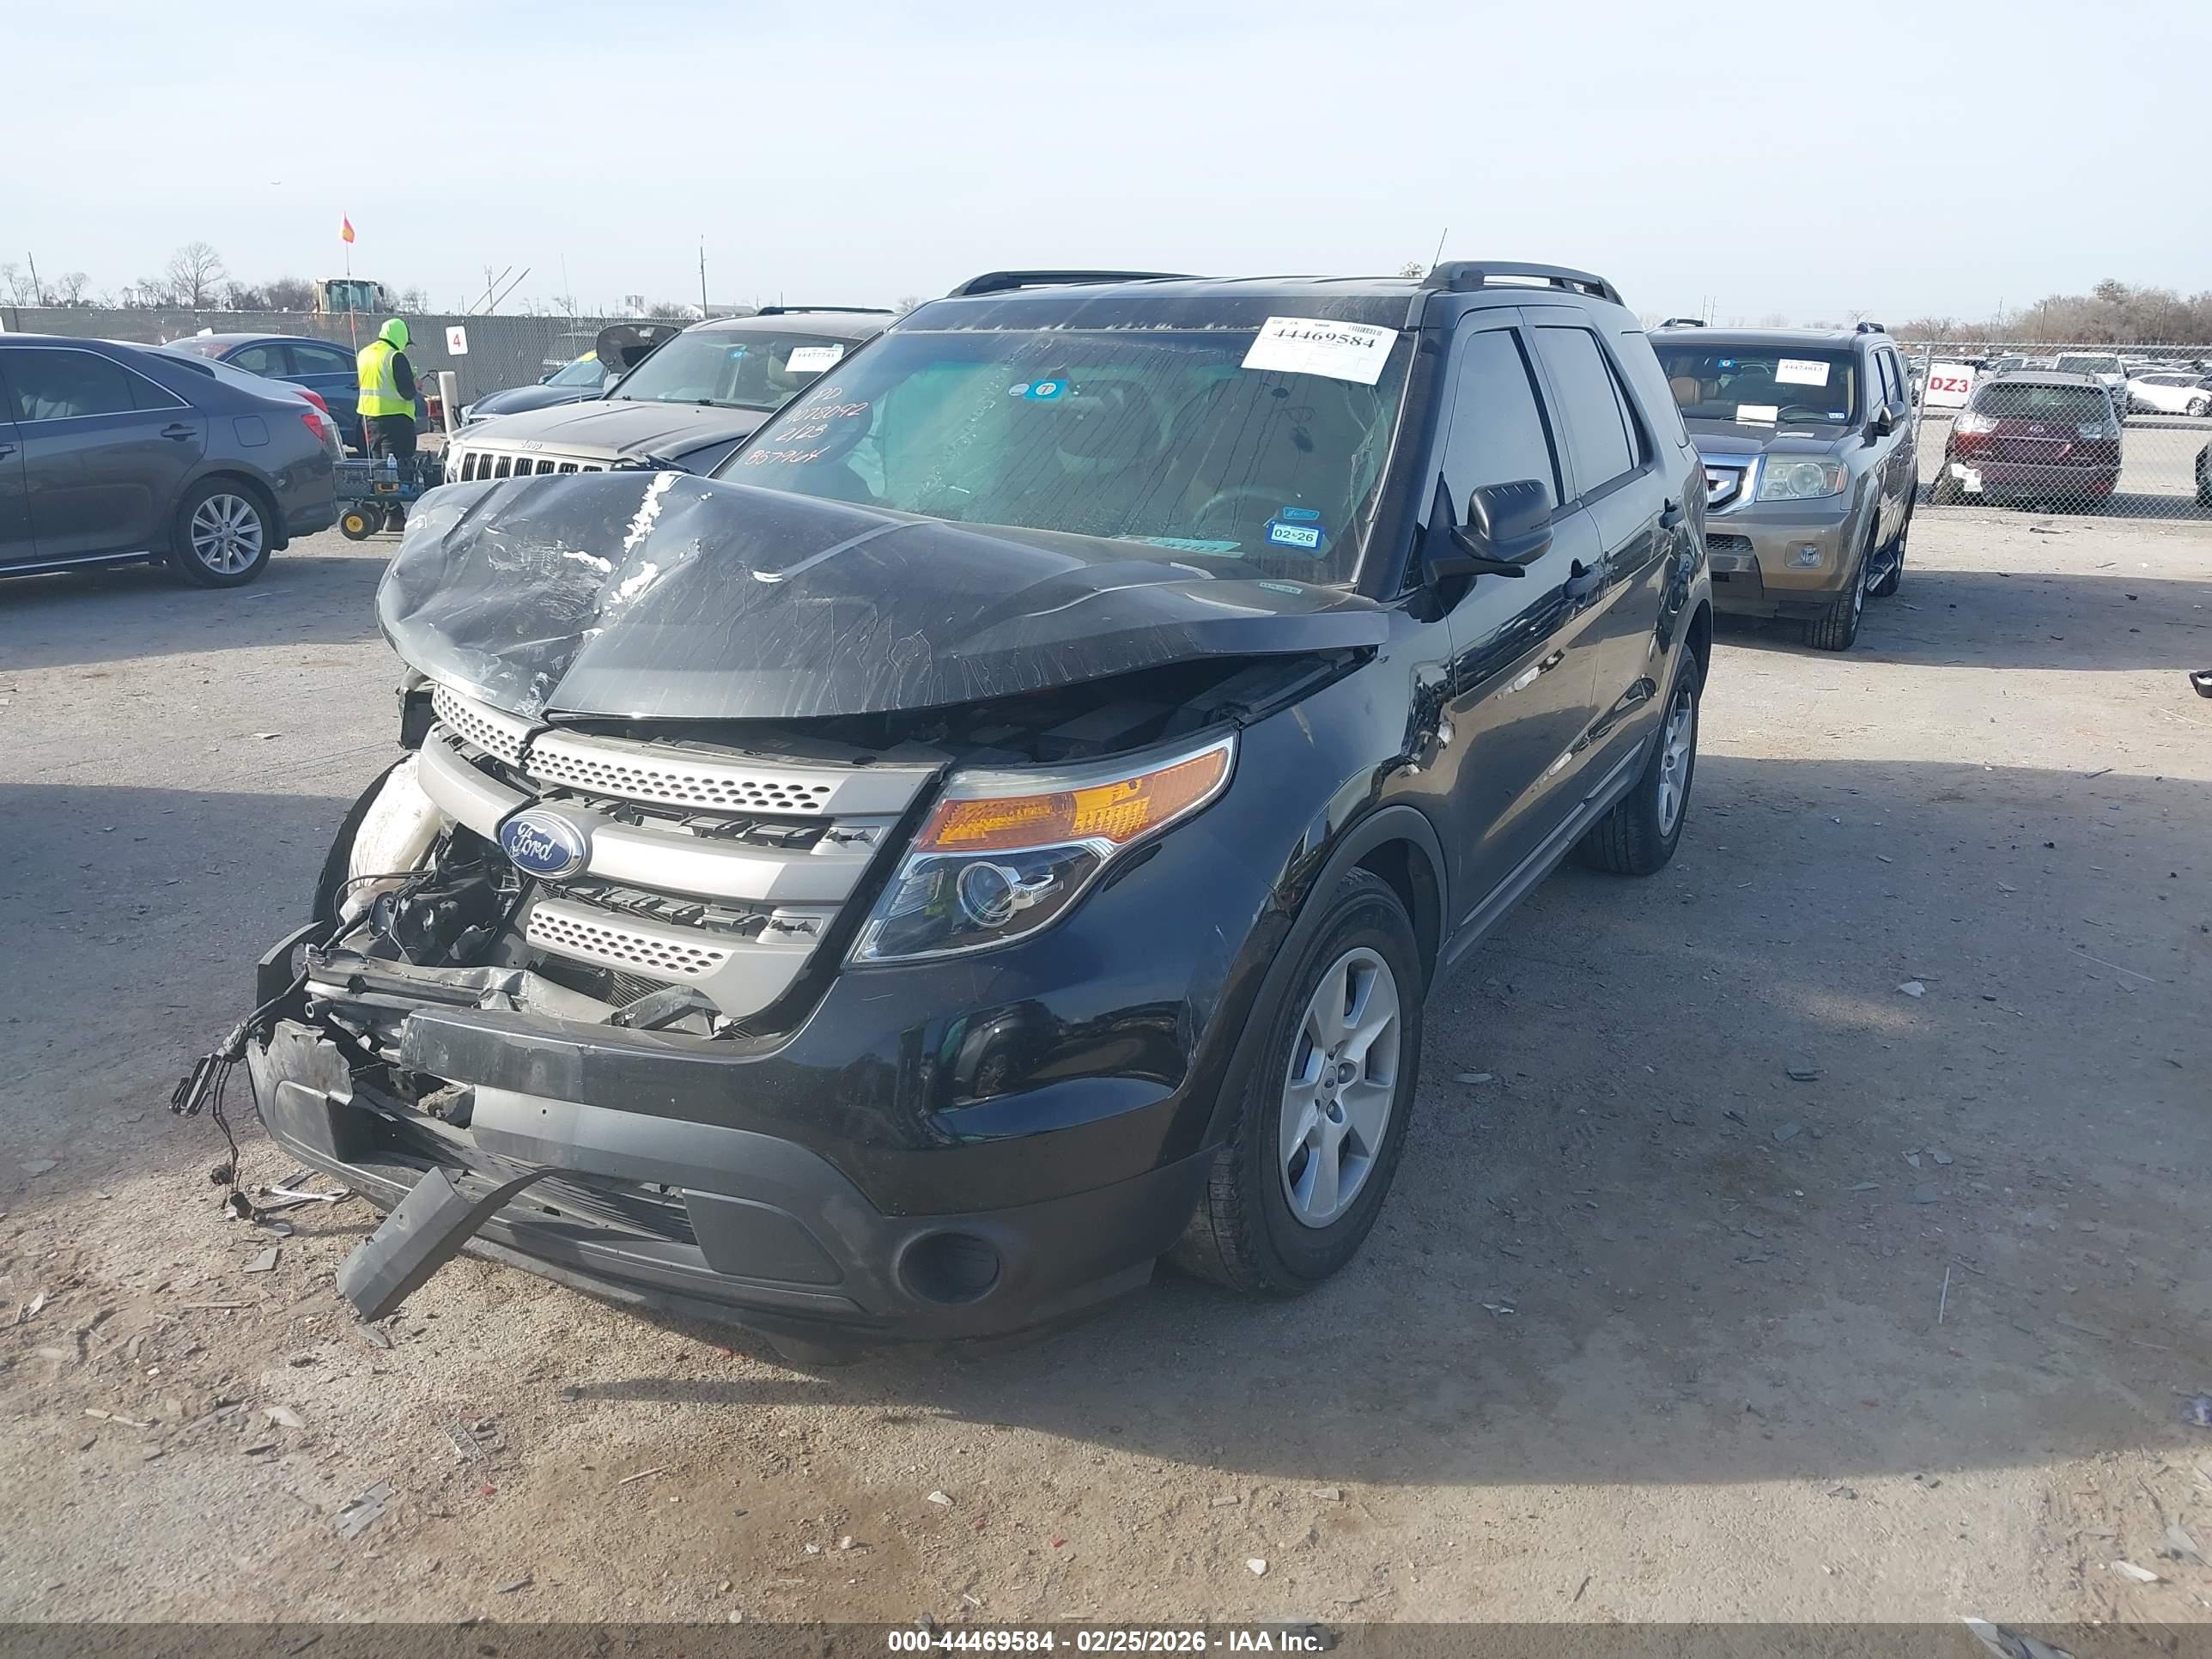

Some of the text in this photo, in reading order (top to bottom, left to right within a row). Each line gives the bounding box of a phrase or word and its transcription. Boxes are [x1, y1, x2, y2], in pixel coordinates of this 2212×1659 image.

[453, 333, 461, 348] 4
[1273, 328, 1376, 349] 44469584
[1929, 377, 1968, 392] DZ3
[775, 422, 829, 443] 2/23
[510, 821, 556, 861] Ford
